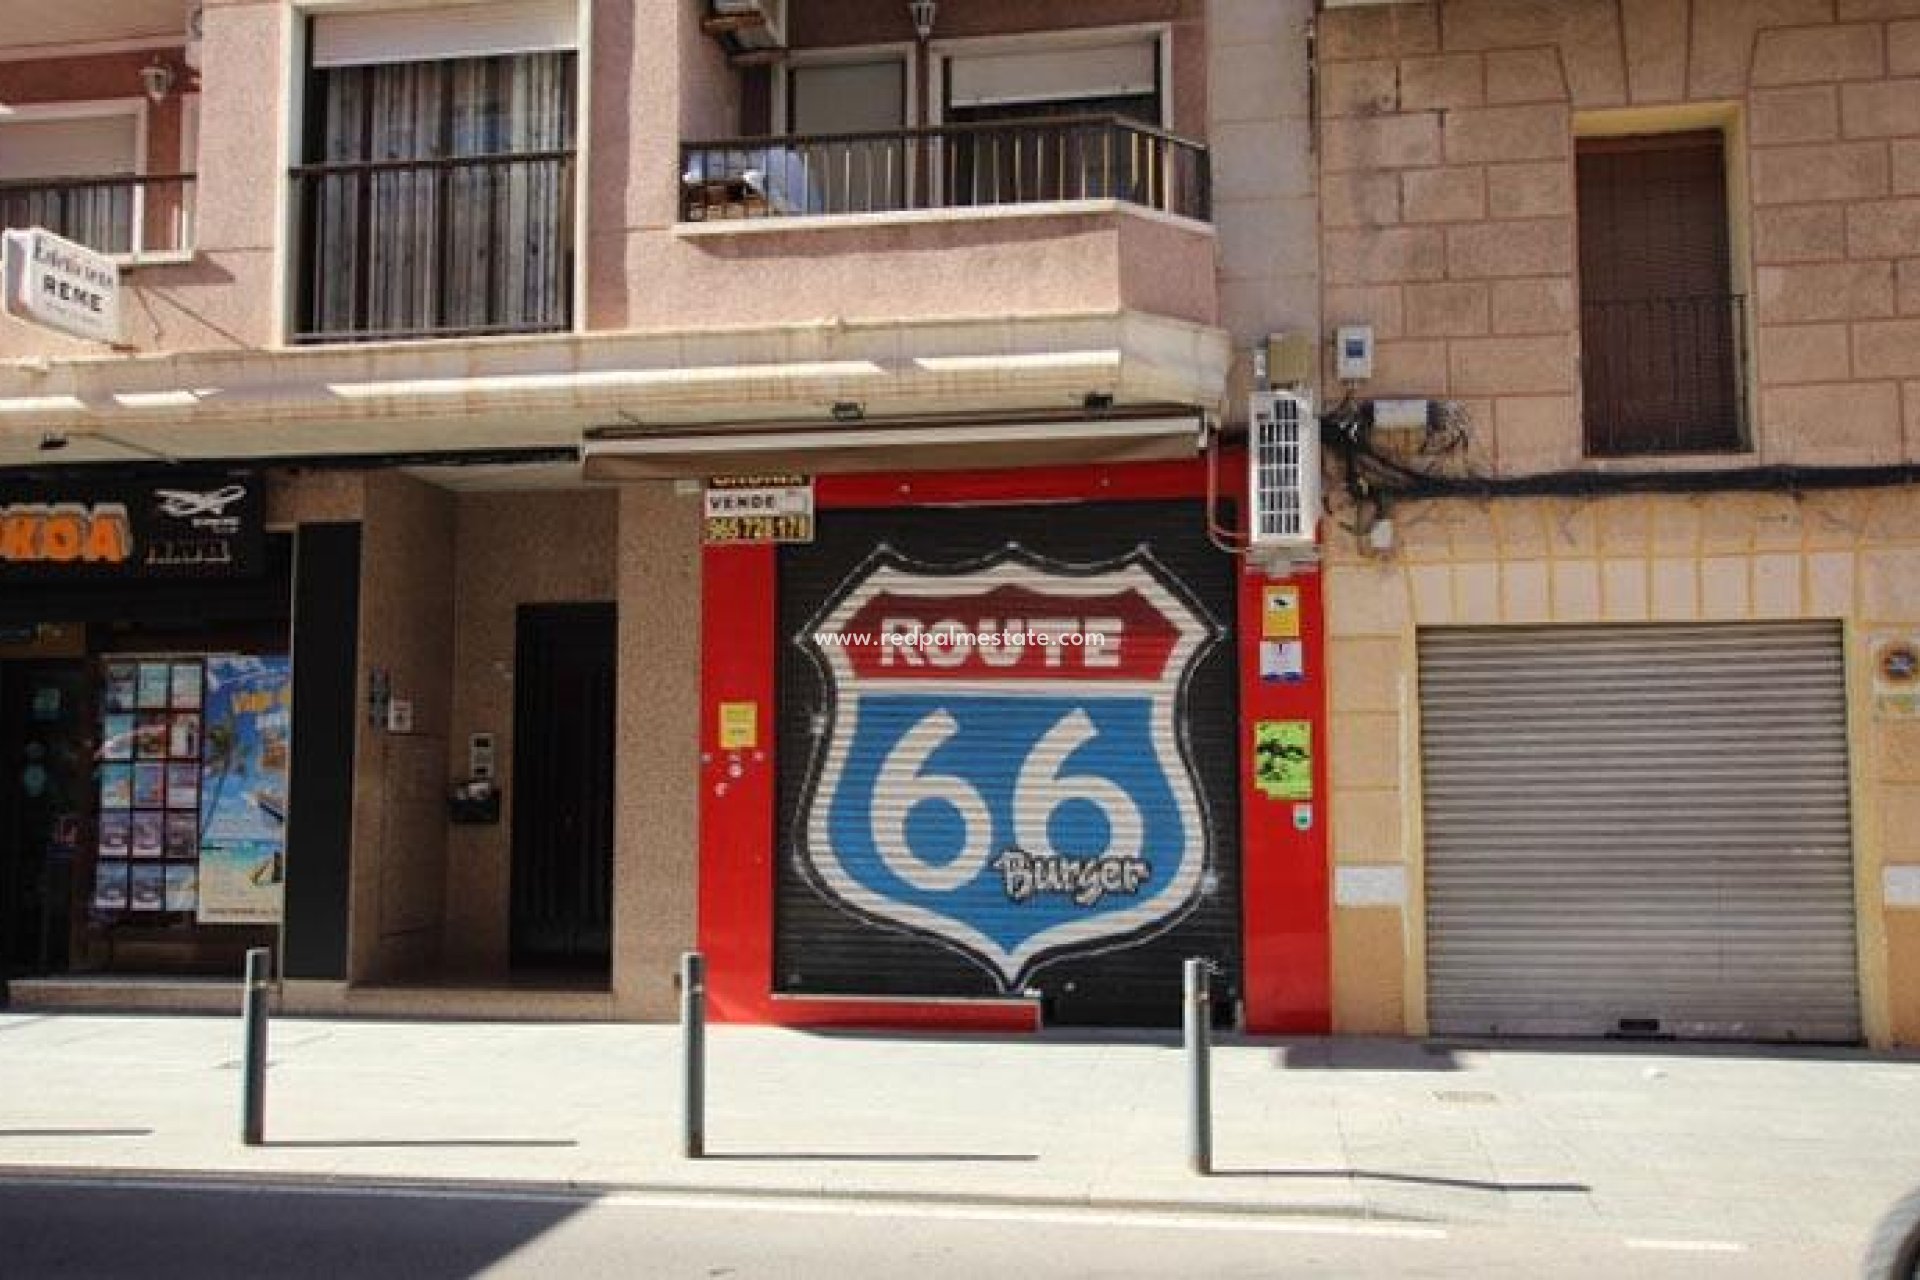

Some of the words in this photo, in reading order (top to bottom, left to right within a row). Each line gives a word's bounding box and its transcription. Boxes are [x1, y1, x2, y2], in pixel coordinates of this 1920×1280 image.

[709, 495, 776, 510] VENDE
[879, 618, 1124, 667] ROUTE
[870, 708, 1144, 890] 66
[993, 847, 1150, 907] Burger
